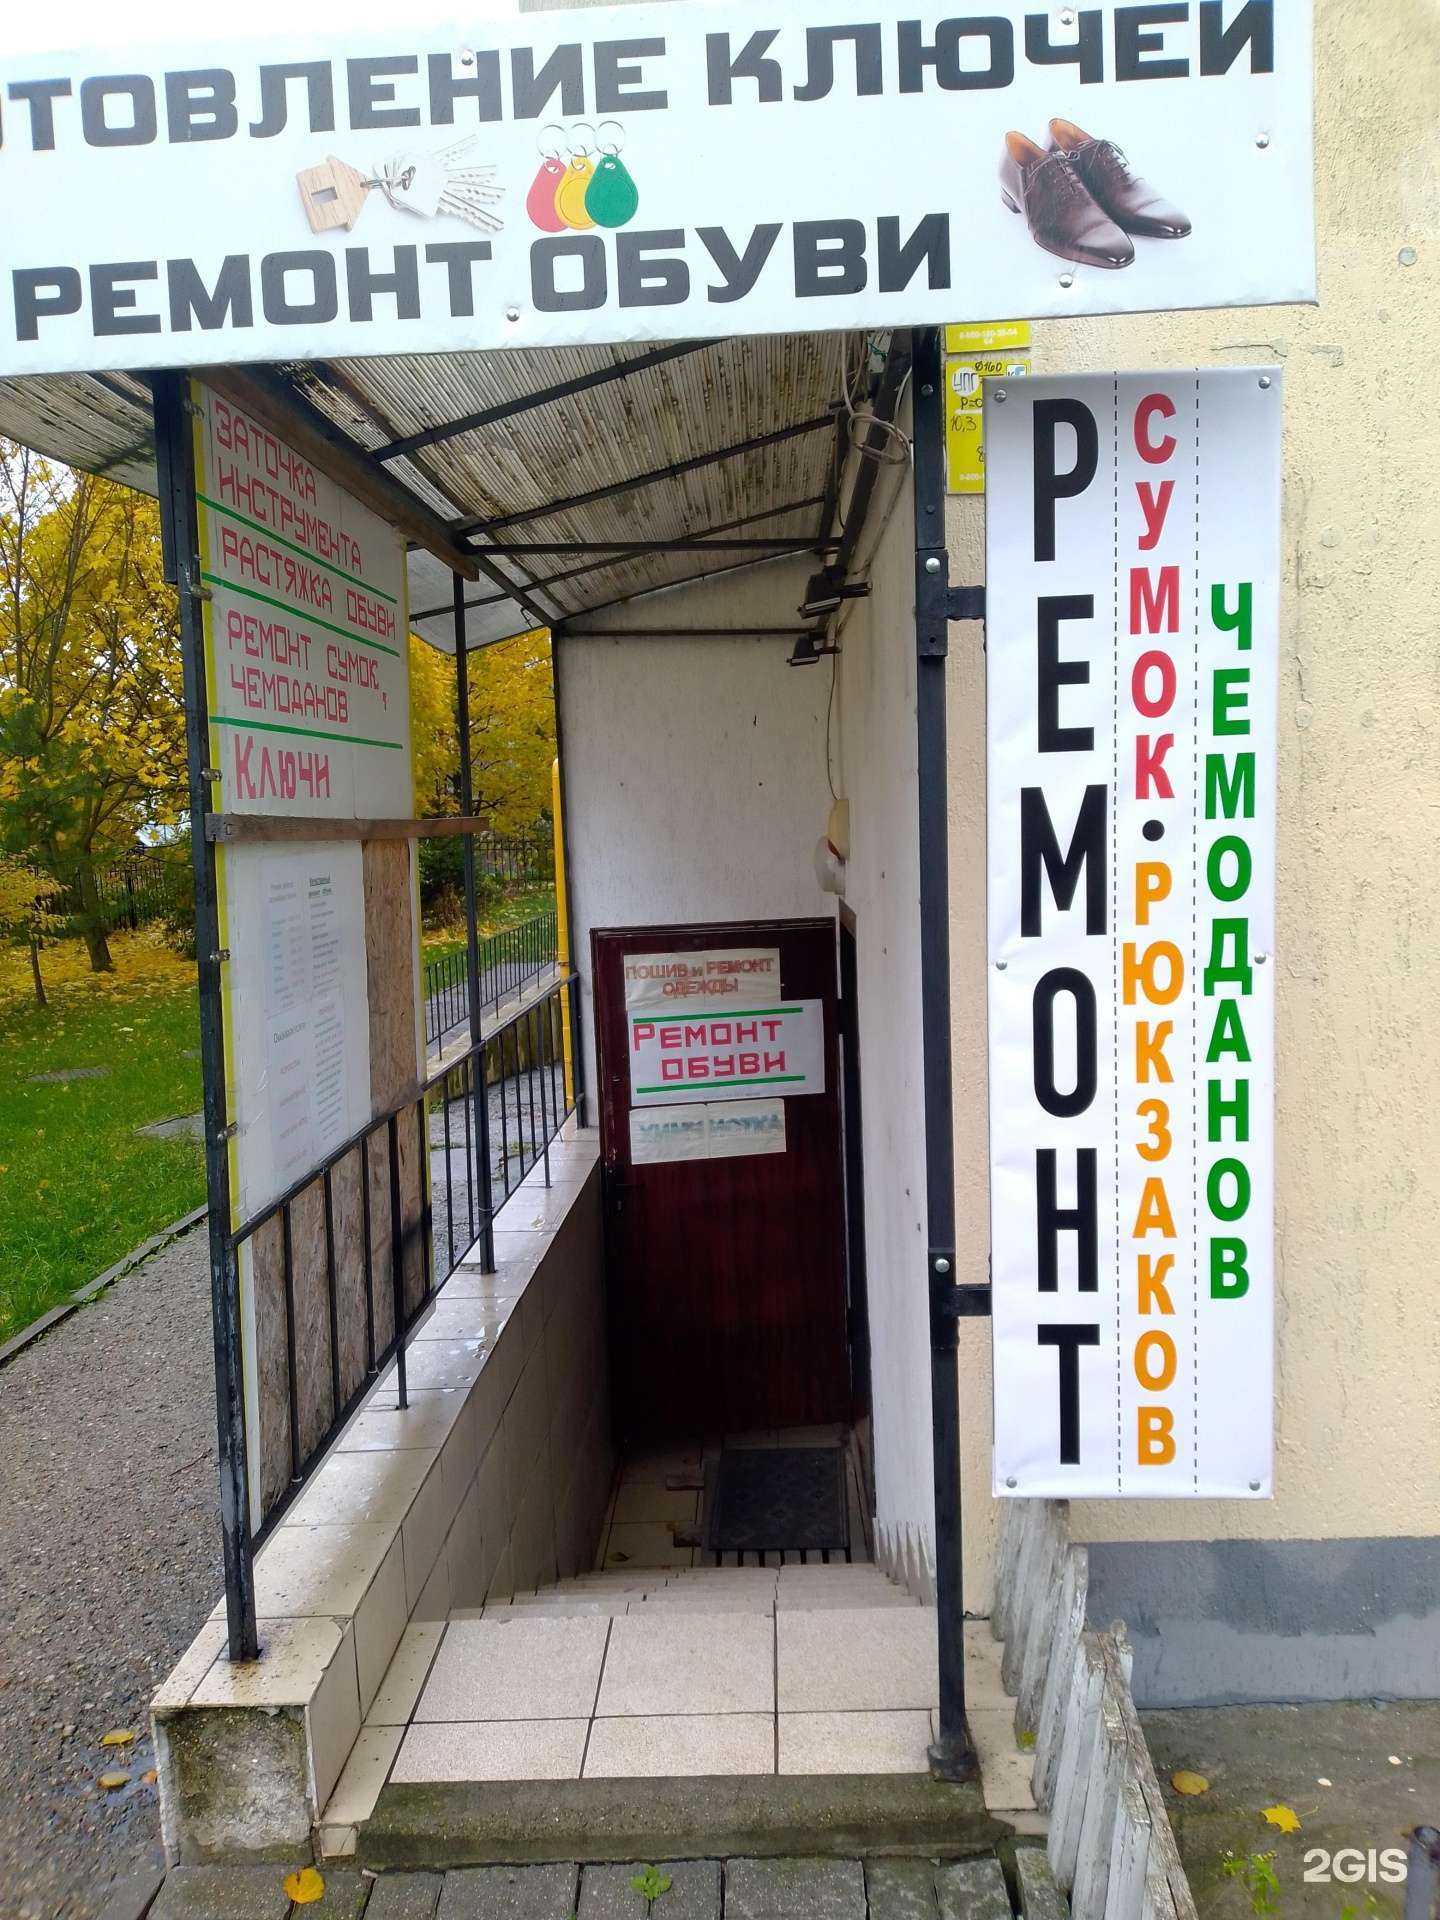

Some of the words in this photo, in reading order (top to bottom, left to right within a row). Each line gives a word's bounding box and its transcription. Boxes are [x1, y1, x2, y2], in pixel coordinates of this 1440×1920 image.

[0, 37, 668, 151] ТОВЛЕНИЕ
[12, 240, 493, 342] РЕМОНТ
[529, 212, 951, 313] ОБУВИ
[214, 400, 317, 507] ЗАТОЧКА
[218, 456, 362, 575] ИНСТРУМЕНТА
[221, 526, 333, 614] РАСТЯЖКА
[346, 588, 397, 641] ОБУВИ
[1129, 393, 1180, 800] СУМОК
[227, 609, 312, 672] РЕМОНТ
[230, 663, 349, 723] ЧЕМОДАНОВ
[234, 734, 332, 800] КЛЮЧИ
[625, 962, 689, 981] ПОШИВ
[705, 957, 775, 976] РЕМОНТ
[1020, 398, 1108, 1465] РЕМОНТ
[1203, 582, 1255, 1299] ЧЕМОДАНОВ
[633, 1020, 784, 1051] РЕМОНТ
[662, 977, 739, 999] ОДЕЖДЫ
[662, 1050, 787, 1081] ОБУВИ
[1122, 861, 1185, 1466] РЮКЗАКОВ
